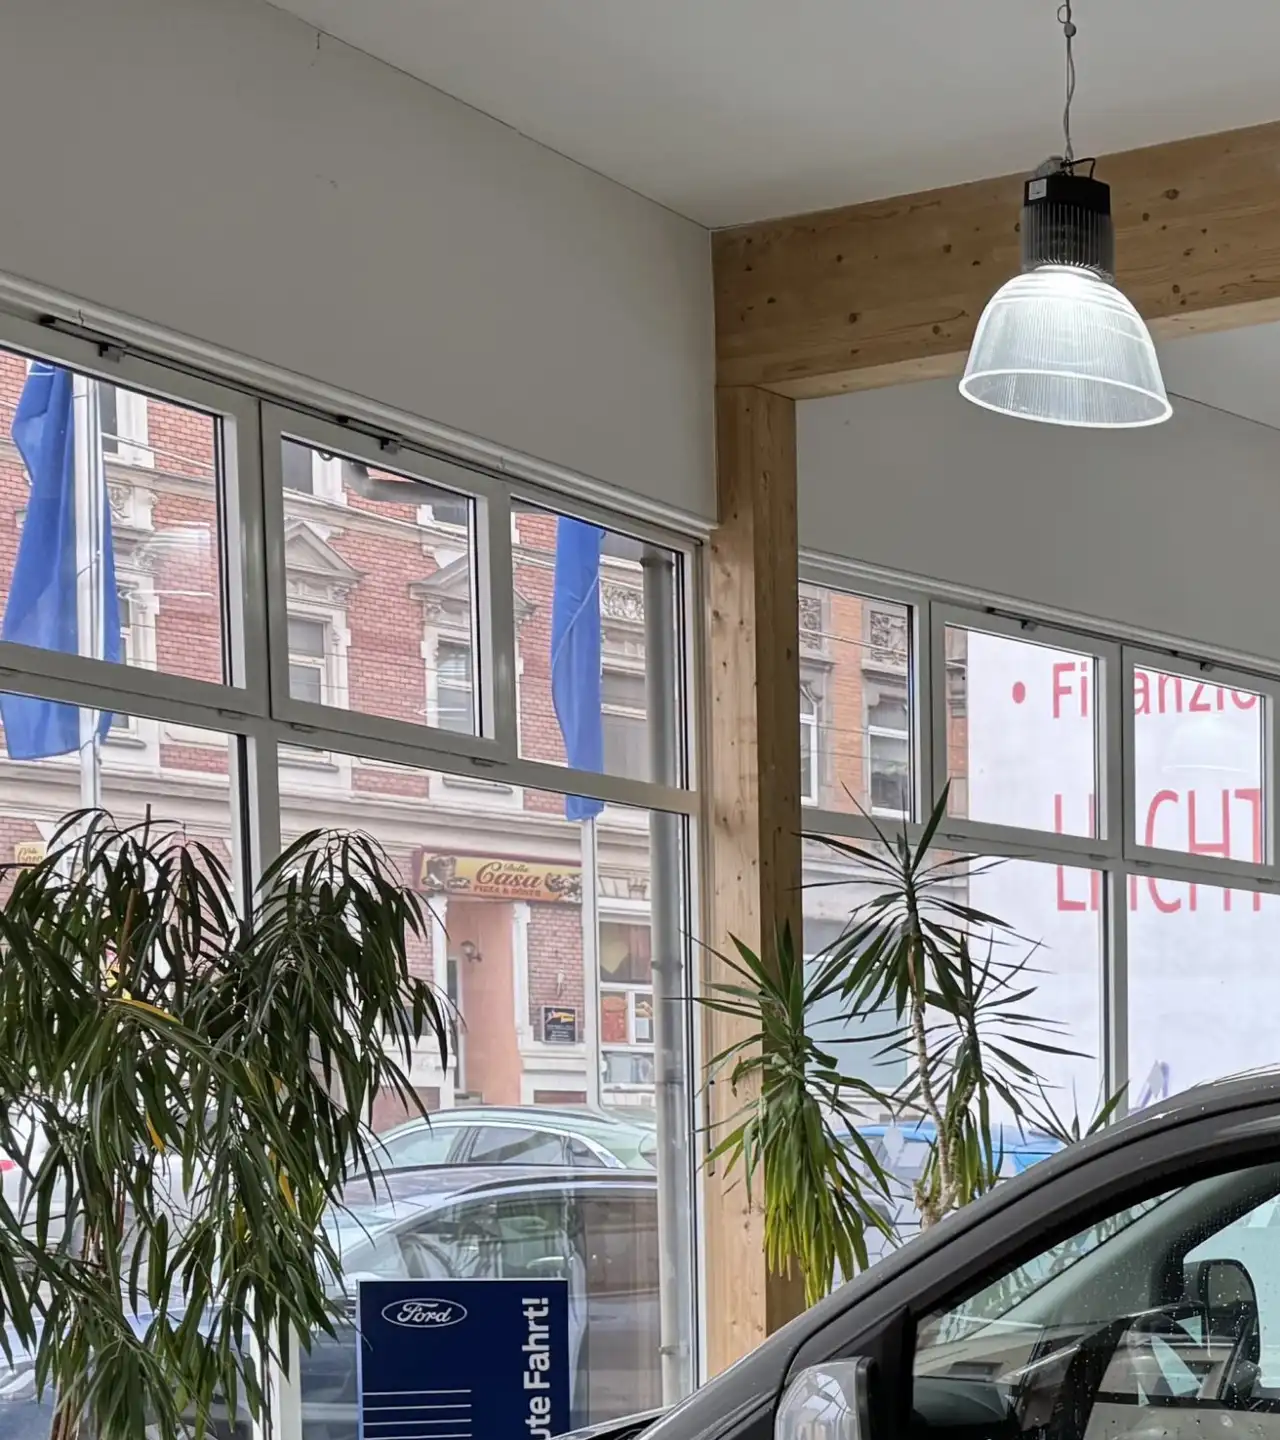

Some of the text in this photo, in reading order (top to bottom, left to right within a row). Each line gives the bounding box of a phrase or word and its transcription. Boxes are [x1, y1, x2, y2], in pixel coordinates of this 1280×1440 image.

[476, 861, 541, 888] Casa
[396, 1301, 452, 1323] Ford
[522, 1298, 550, 1390] Fahrt!
